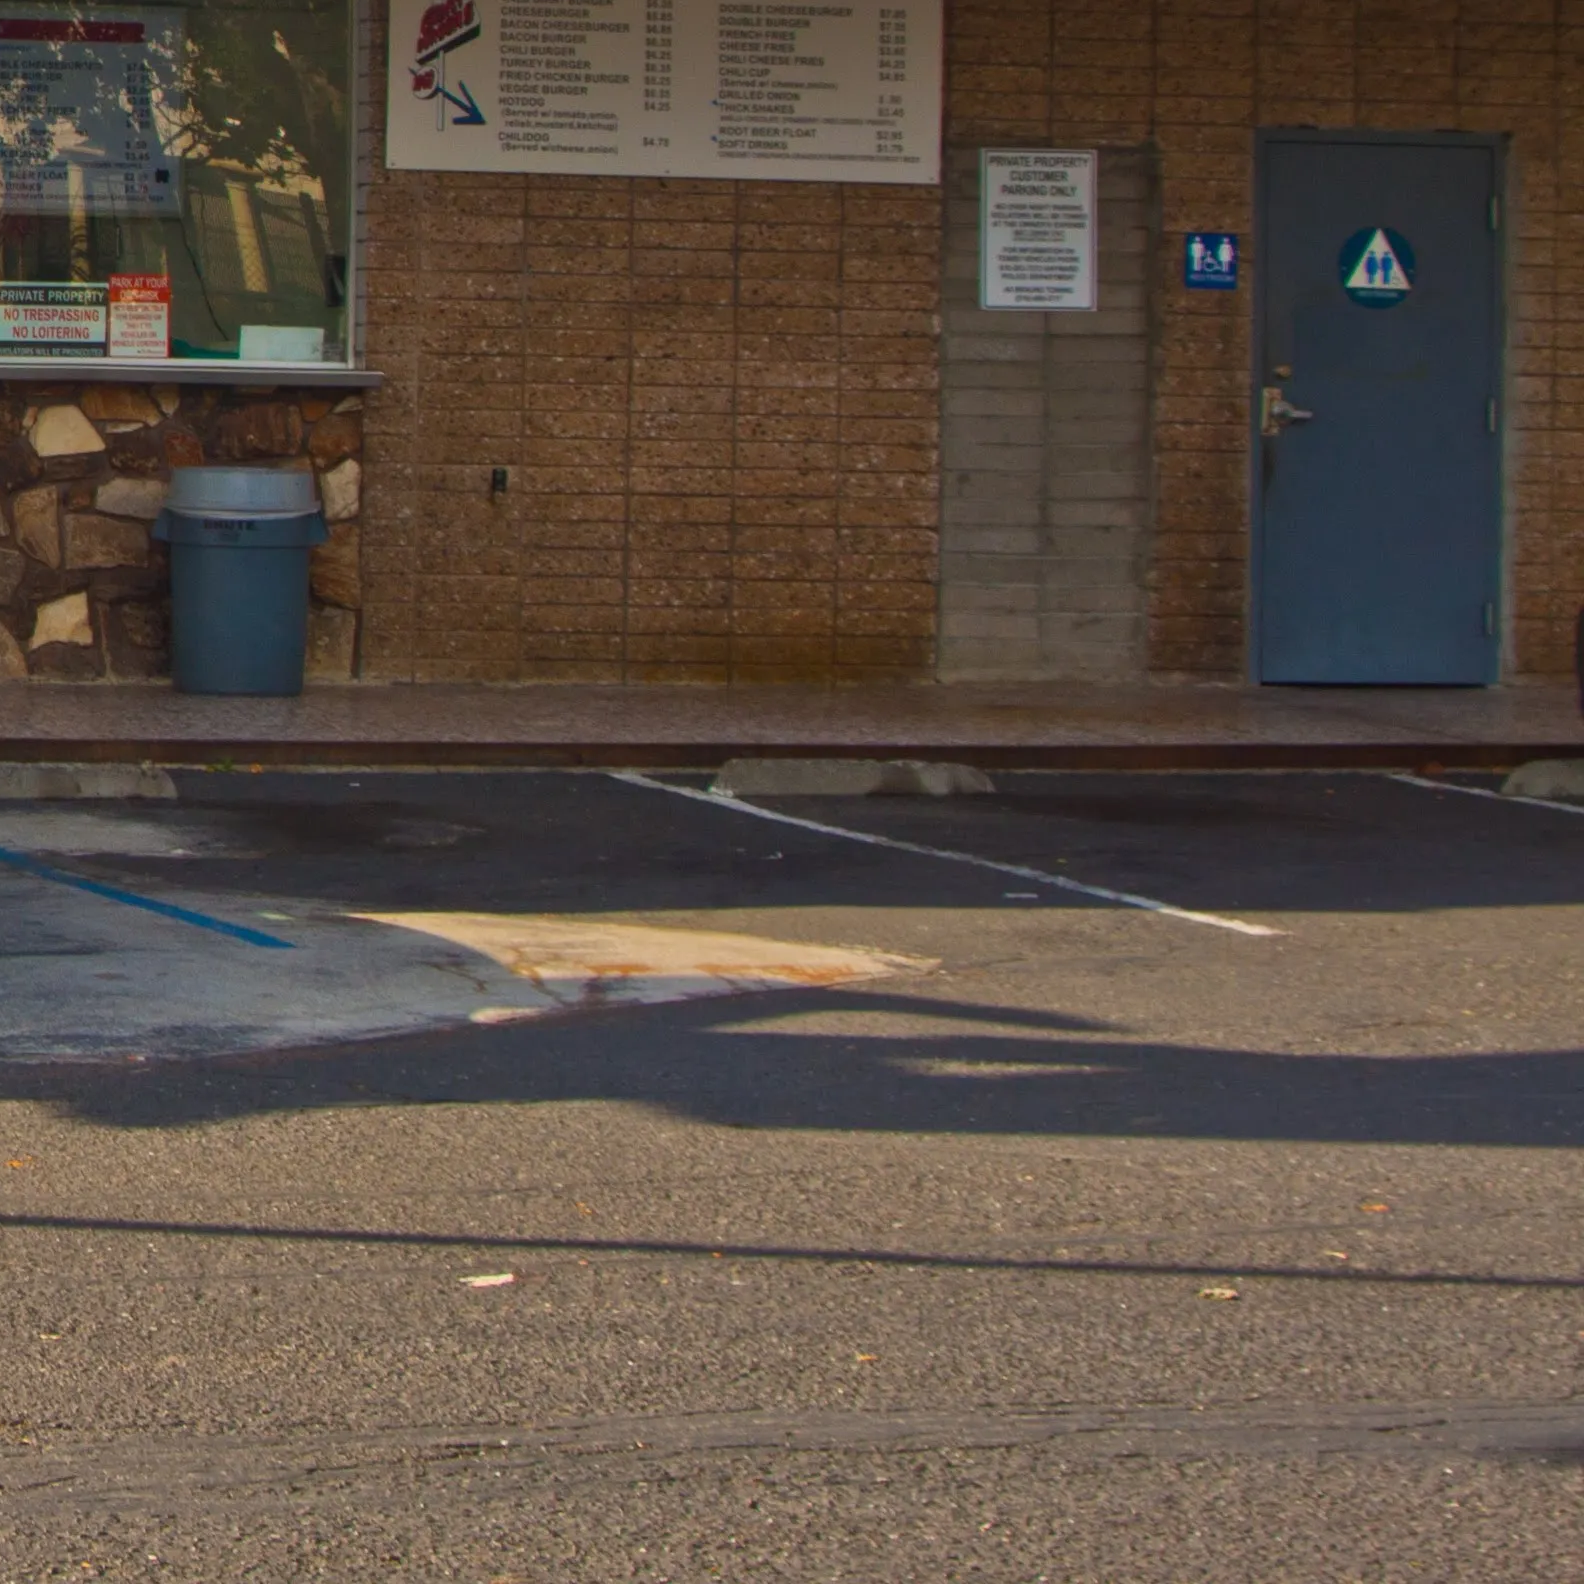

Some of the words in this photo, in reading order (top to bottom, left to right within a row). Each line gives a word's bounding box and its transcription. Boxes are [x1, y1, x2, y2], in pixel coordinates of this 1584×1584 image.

[501, 6, 590, 18] CHEESEBURGER
[719, 4, 761, 14] DOUBLE
[765, 5, 852, 17] CHEESEBURGER
[501, 19, 538, 29] BACON
[541, 20, 630, 33] CHEESEBURGER
[719, 16, 761, 26] DOUBLE
[764, 18, 810, 28] BURGER
[501, 32, 538, 42] BACON
[541, 33, 587, 44] BURGER
[719, 29, 761, 39] FRENCH
[764, 31, 796, 41] FRIES
[501, 45, 527, 55] CHILI
[530, 46, 576, 57] BURGER
[719, 42, 761, 52] CHEESE
[763, 43, 795, 53] FRIES
[500, 57, 543, 68] TURKEY
[545, 59, 591, 70] BURGER
[719, 55, 746, 64] CHILI
[748, 56, 790, 66] CHEESE
[794, 57, 826, 67] FRIES
[500, 70, 532, 81] FRIED
[534, 71, 581, 82] CHICKEN
[584, 73, 630, 84] BURGER
[719, 67, 746, 77] CHILI
[748, 68, 771, 78] CUP
[499, 83, 539, 93] VEGGIE
[542, 85, 588, 95] BURGER
[499, 96, 545, 106] HOTDOG
[719, 90, 763, 100] GRILLED
[767, 91, 801, 101] ONION
[499, 131, 550, 142] CHILIDOG
[719, 126, 747, 136] ROOT
[751, 127, 780, 137] BEER
[783, 127, 817, 138] FLOAT
[718, 139, 745, 149] SOFT
[748, 140, 788, 150] DRINKS
[989, 156, 1030, 167] PRIVATE
[1033, 156, 1089, 168] PROPERTY
[1009, 170, 1069, 182] CUSTOMER
[1001, 184, 1048, 196] PARKING
[1050, 186, 1077, 197] ONLY
[134, 277, 144, 287] AT
[0, 289, 45, 302] PRIVATE
[48, 289, 105, 303] PROPERTY
[3, 308, 20, 321] NO
[23, 308, 100, 323] TRESPASSING
[12, 326, 29, 340] NO
[31, 326, 90, 341] LOITERING
